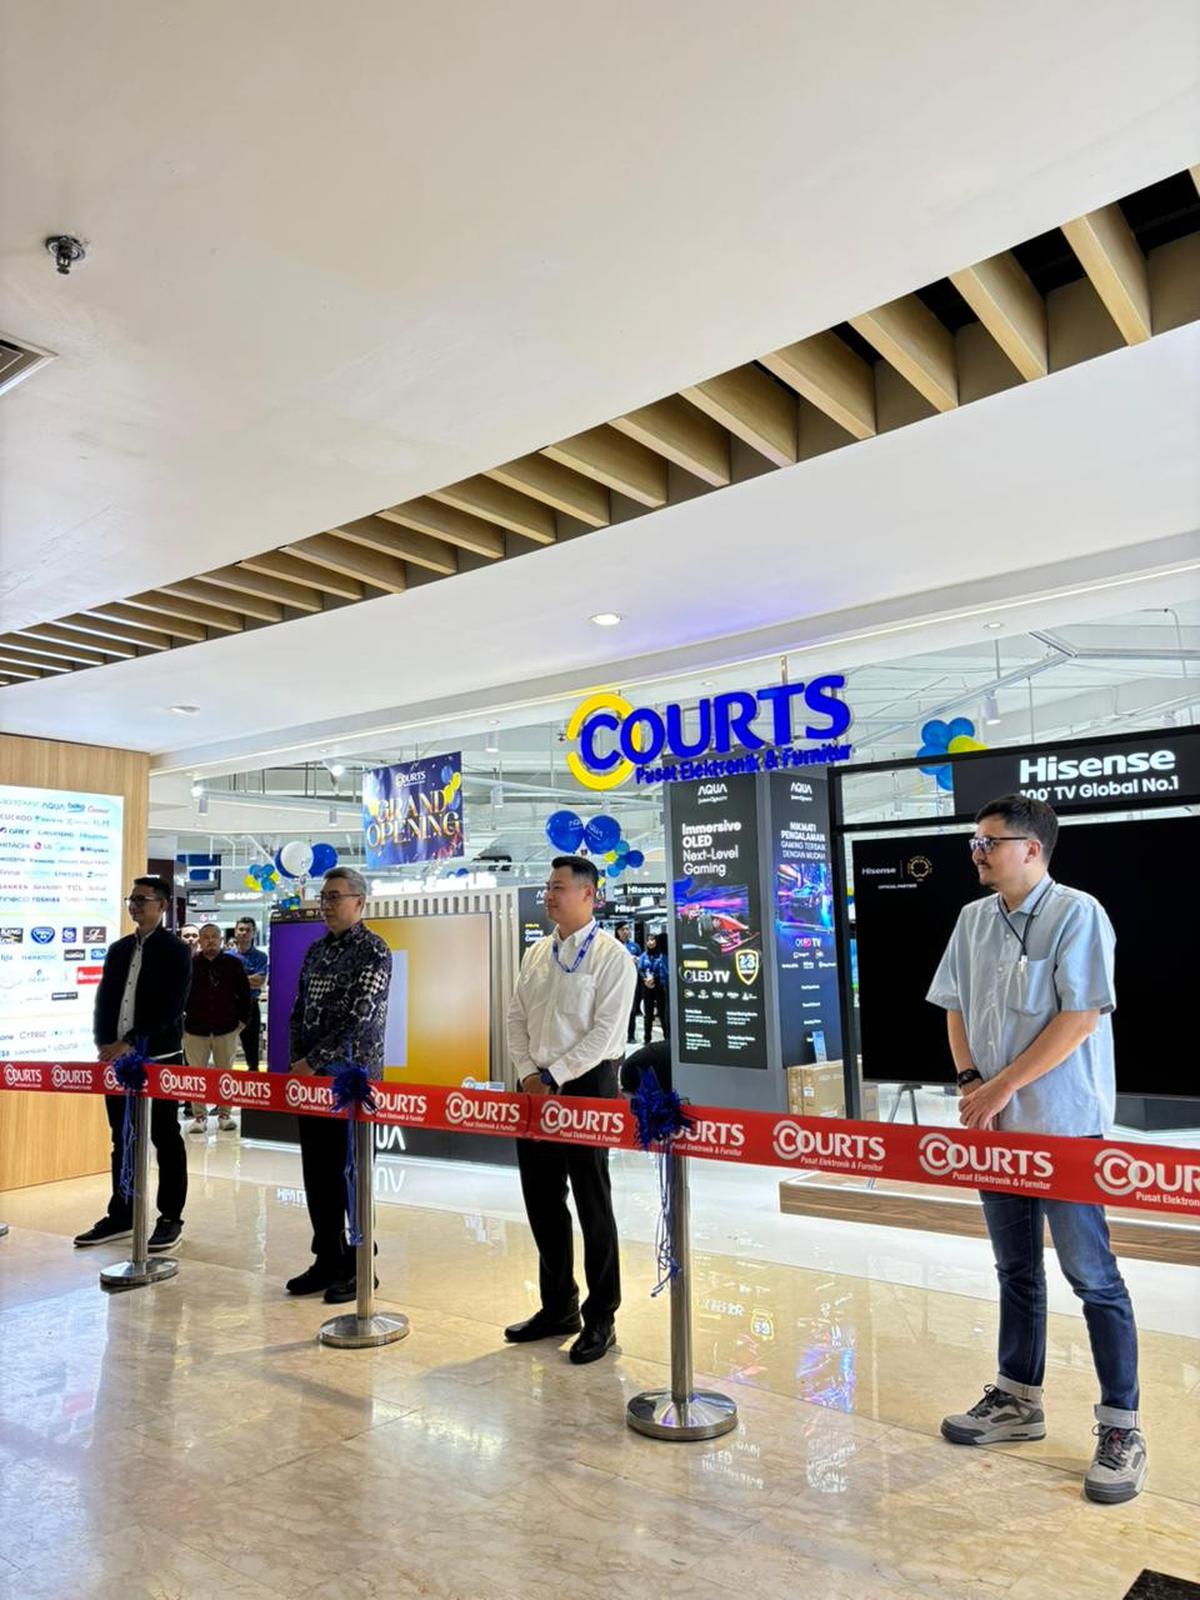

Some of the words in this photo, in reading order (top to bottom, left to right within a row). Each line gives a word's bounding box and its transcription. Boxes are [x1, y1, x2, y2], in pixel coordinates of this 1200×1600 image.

[568, 674, 851, 778] COURTS
[636, 766, 677, 784] Pusat
[681, 754, 760, 779] Elektronik
[765, 749, 779, 769] &
[782, 744, 852, 767] Furnitur
[1020, 750, 1176, 784] Hisense
[698, 783, 728, 796] AQUA
[790, 782, 813, 794] AQUA
[1054, 785, 1076, 800] TV
[1079, 778, 1139, 798] Global
[1142, 776, 1179, 793] No.1
[377, 789, 446, 822] GRAND
[367, 811, 459, 848] OPENING
[682, 819, 742, 836] Immersive
[683, 845, 739, 862] Next-Level
[683, 862, 726, 877] Gaming
[862, 867, 897, 875] Hisense
[627, 886, 665, 896] Hisense
[713, 970, 730, 983] TV
[4, 1064, 42, 1085] COURTS
[52, 1065, 93, 1086] COURTS
[160, 1069, 207, 1093] COURTS
[220, 1074, 272, 1099] COURTS
[286, 1080, 334, 1106] COURT
[367, 1088, 427, 1115] OURTS
[446, 1092, 520, 1124] COURTS
[541, 1100, 624, 1134] COURTS
[671, 1120, 745, 1147] URTS
[773, 1120, 886, 1161] COURTS
[801, 1157, 818, 1165] Pusat
[819, 1158, 849, 1169] Elektronik
[851, 1160, 856, 1169] &
[857, 1162, 883, 1172] Furnitur
[919, 1133, 1054, 1177] COURTS
[953, 1171, 973, 1181] Pusat
[974, 1173, 1011, 1185] Elektronik
[1013, 1178, 1018, 1186] &
[1020, 1179, 1051, 1190] Furnitur
[1094, 1149, 1200, 1195] COUR
[1136, 1191, 1161, 1203] Pusat
[1163, 1193, 1200, 1207] Elektron
